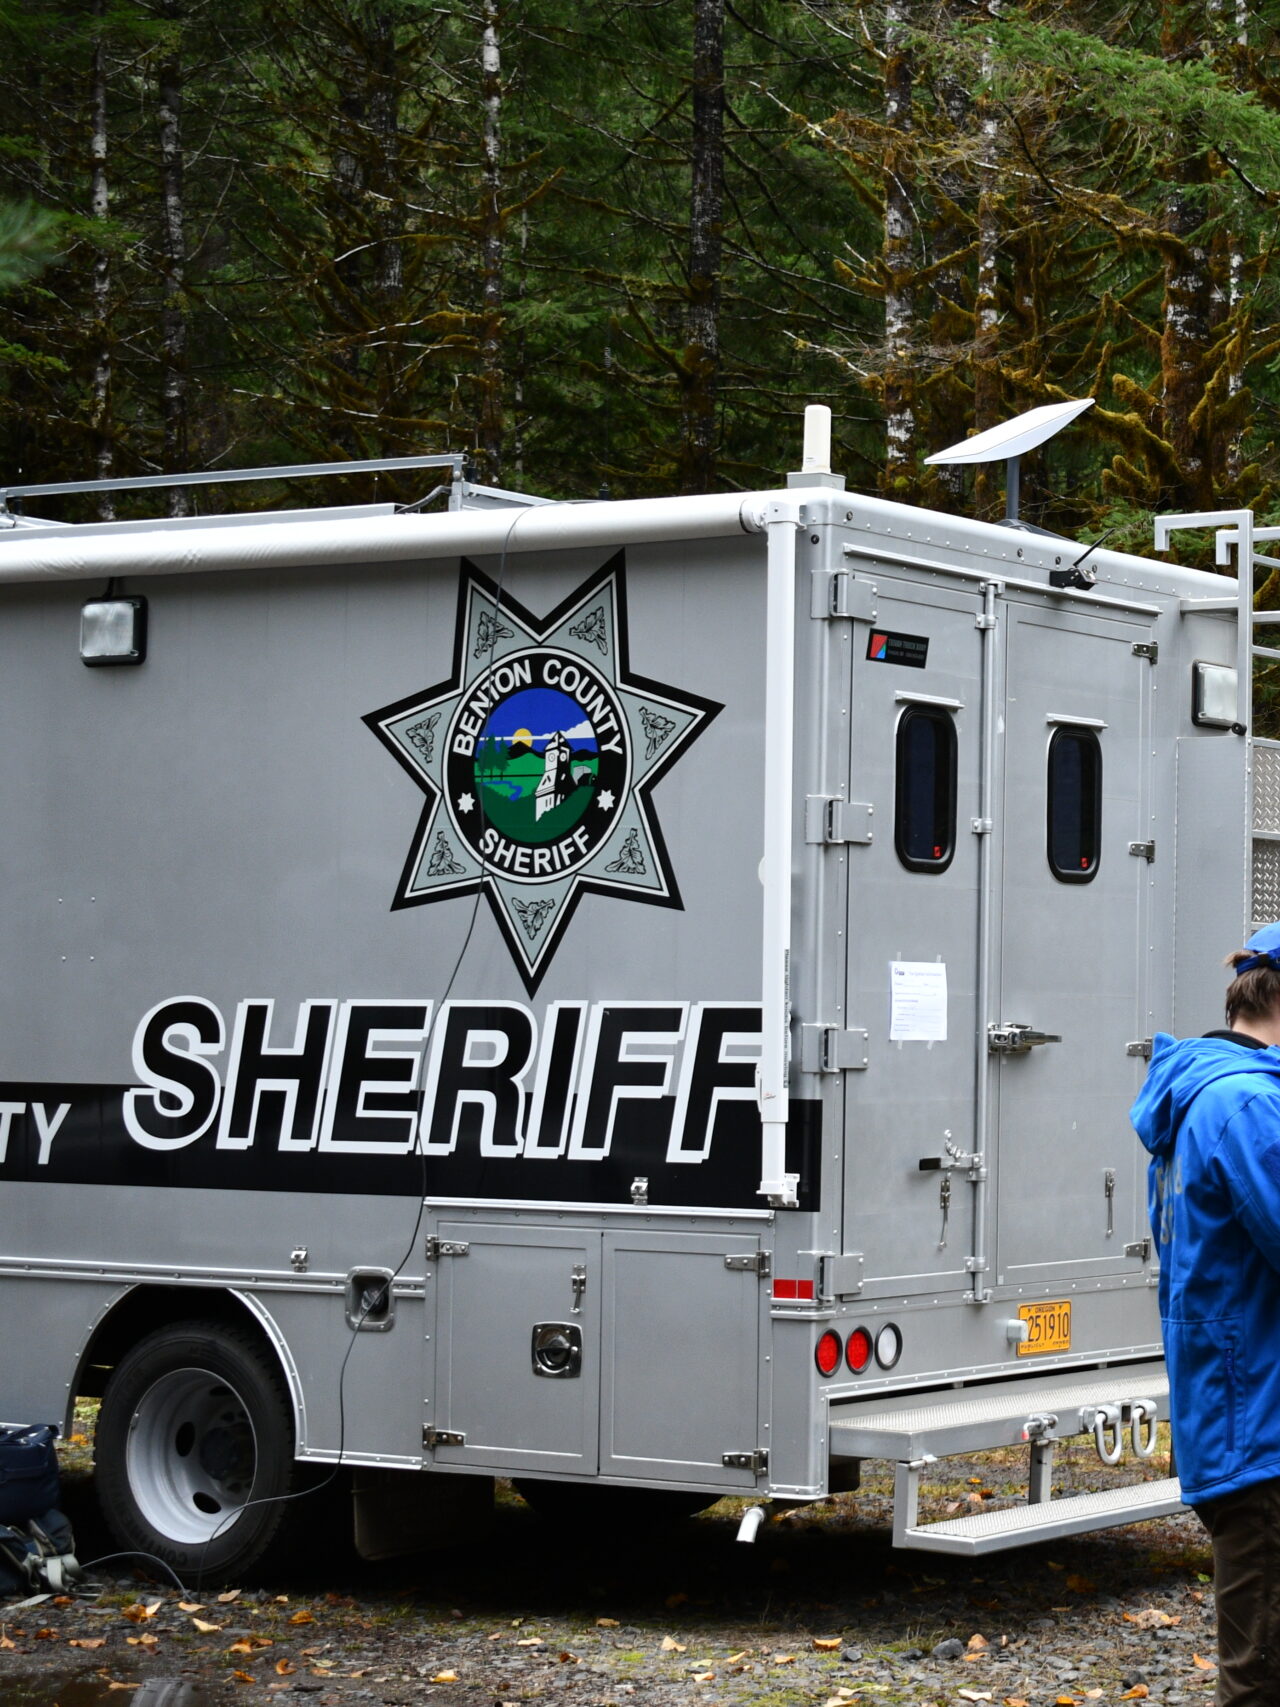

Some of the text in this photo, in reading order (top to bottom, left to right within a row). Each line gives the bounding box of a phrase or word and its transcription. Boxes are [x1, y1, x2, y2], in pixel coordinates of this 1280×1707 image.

[453, 659, 623, 757] BENTON COUNTY
[478, 826, 590, 874] SHERIFF
[122, 995, 763, 1164] SHERIFF
[1023, 1312, 1070, 1343] 251910
[1035, 1305, 1055, 1313] OREGON
